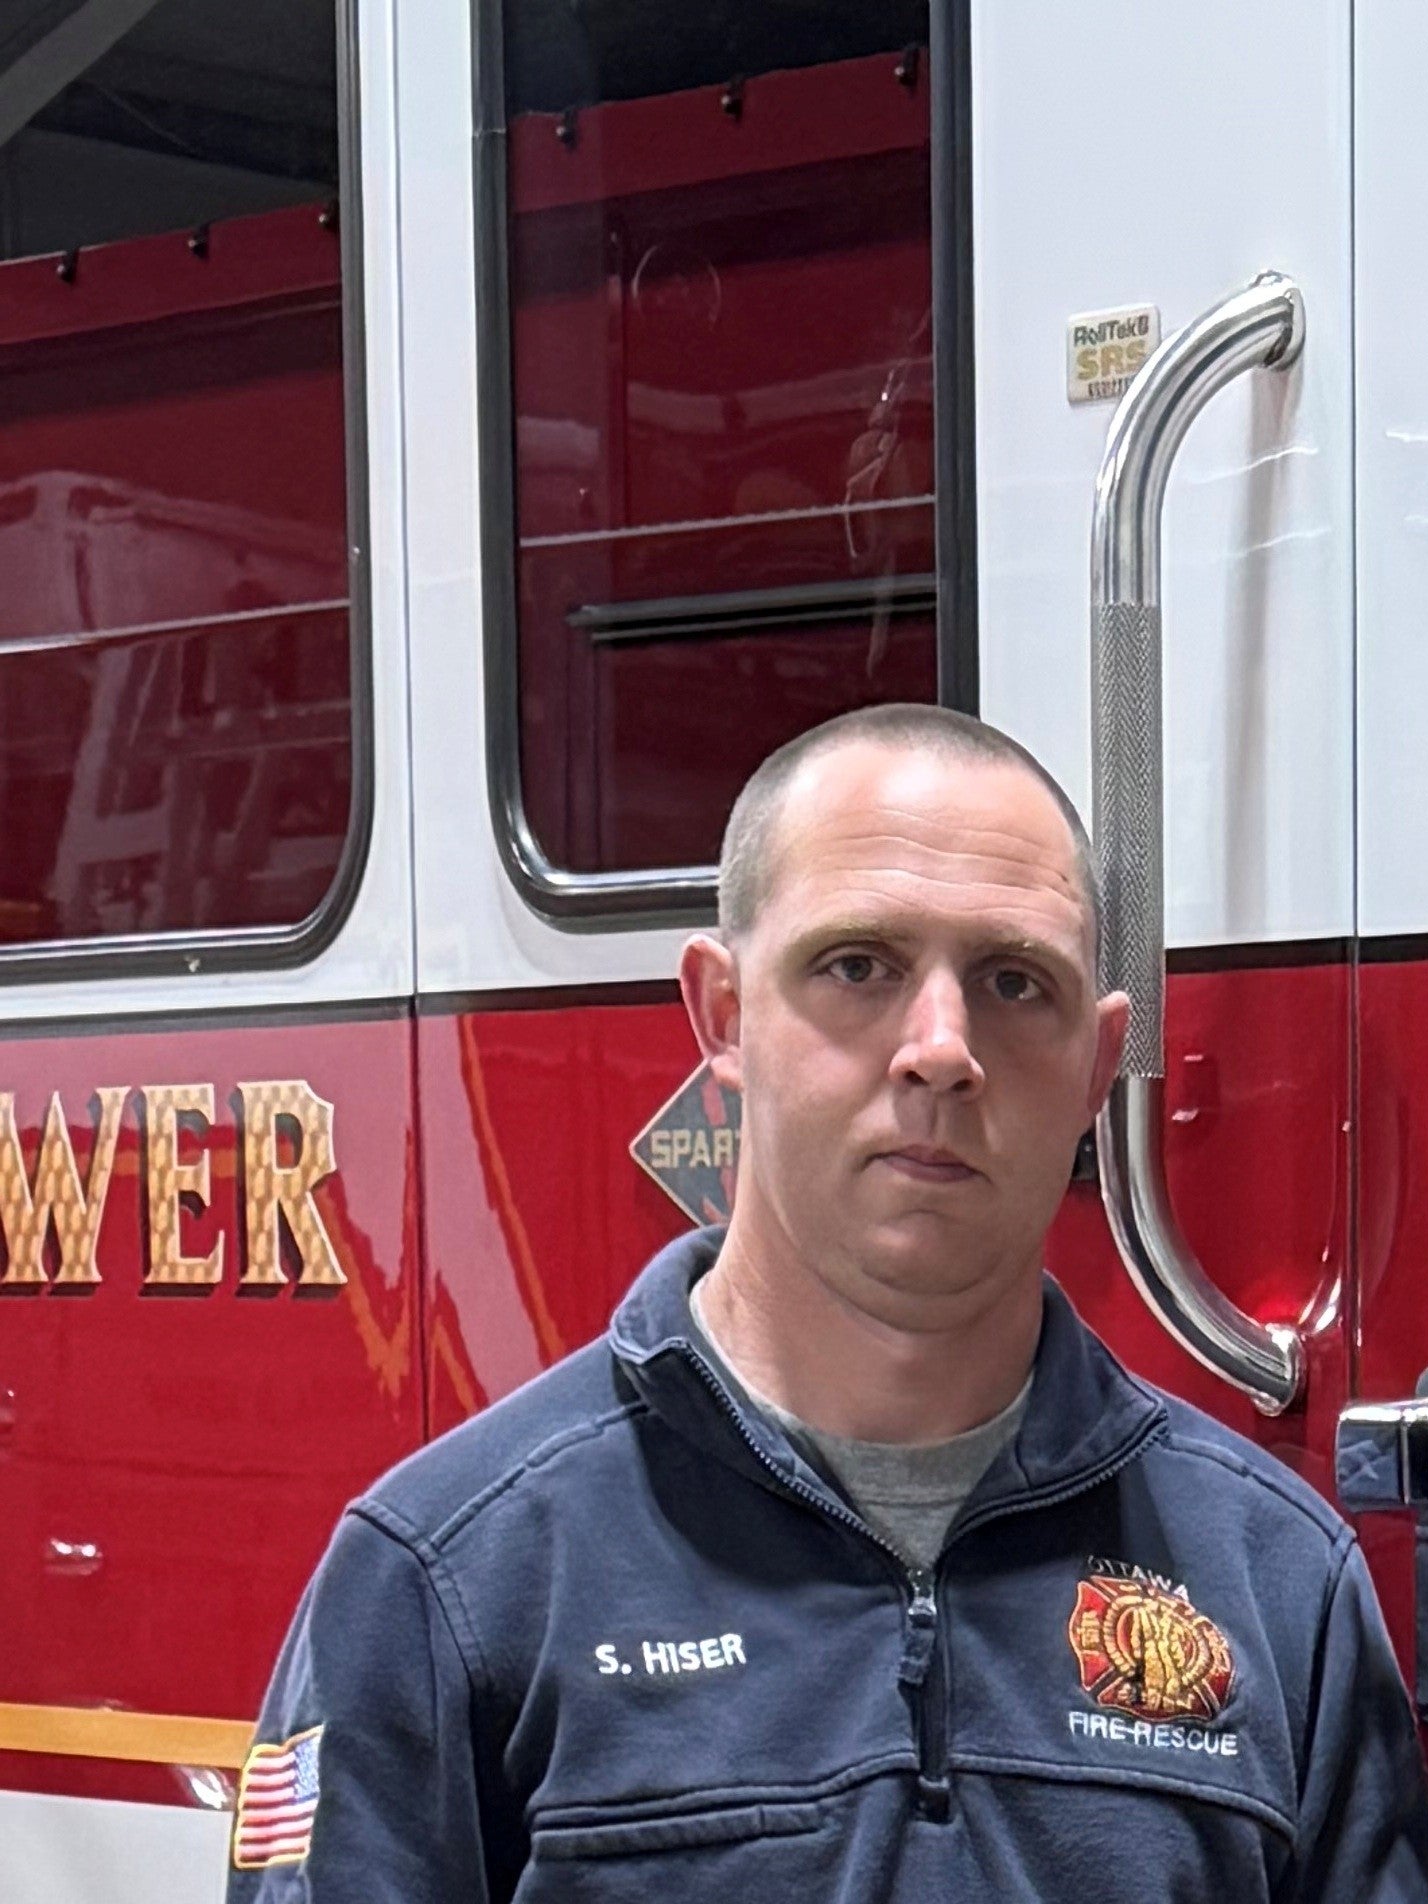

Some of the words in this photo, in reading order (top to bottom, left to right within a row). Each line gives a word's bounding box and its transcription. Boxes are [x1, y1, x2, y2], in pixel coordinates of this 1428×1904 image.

[1087, 1554, 1190, 1602] OTTAWA
[594, 1641, 632, 1677] S.
[641, 1632, 747, 1674] HISER
[1068, 1710, 1239, 1756] FIRE-RESCUE
